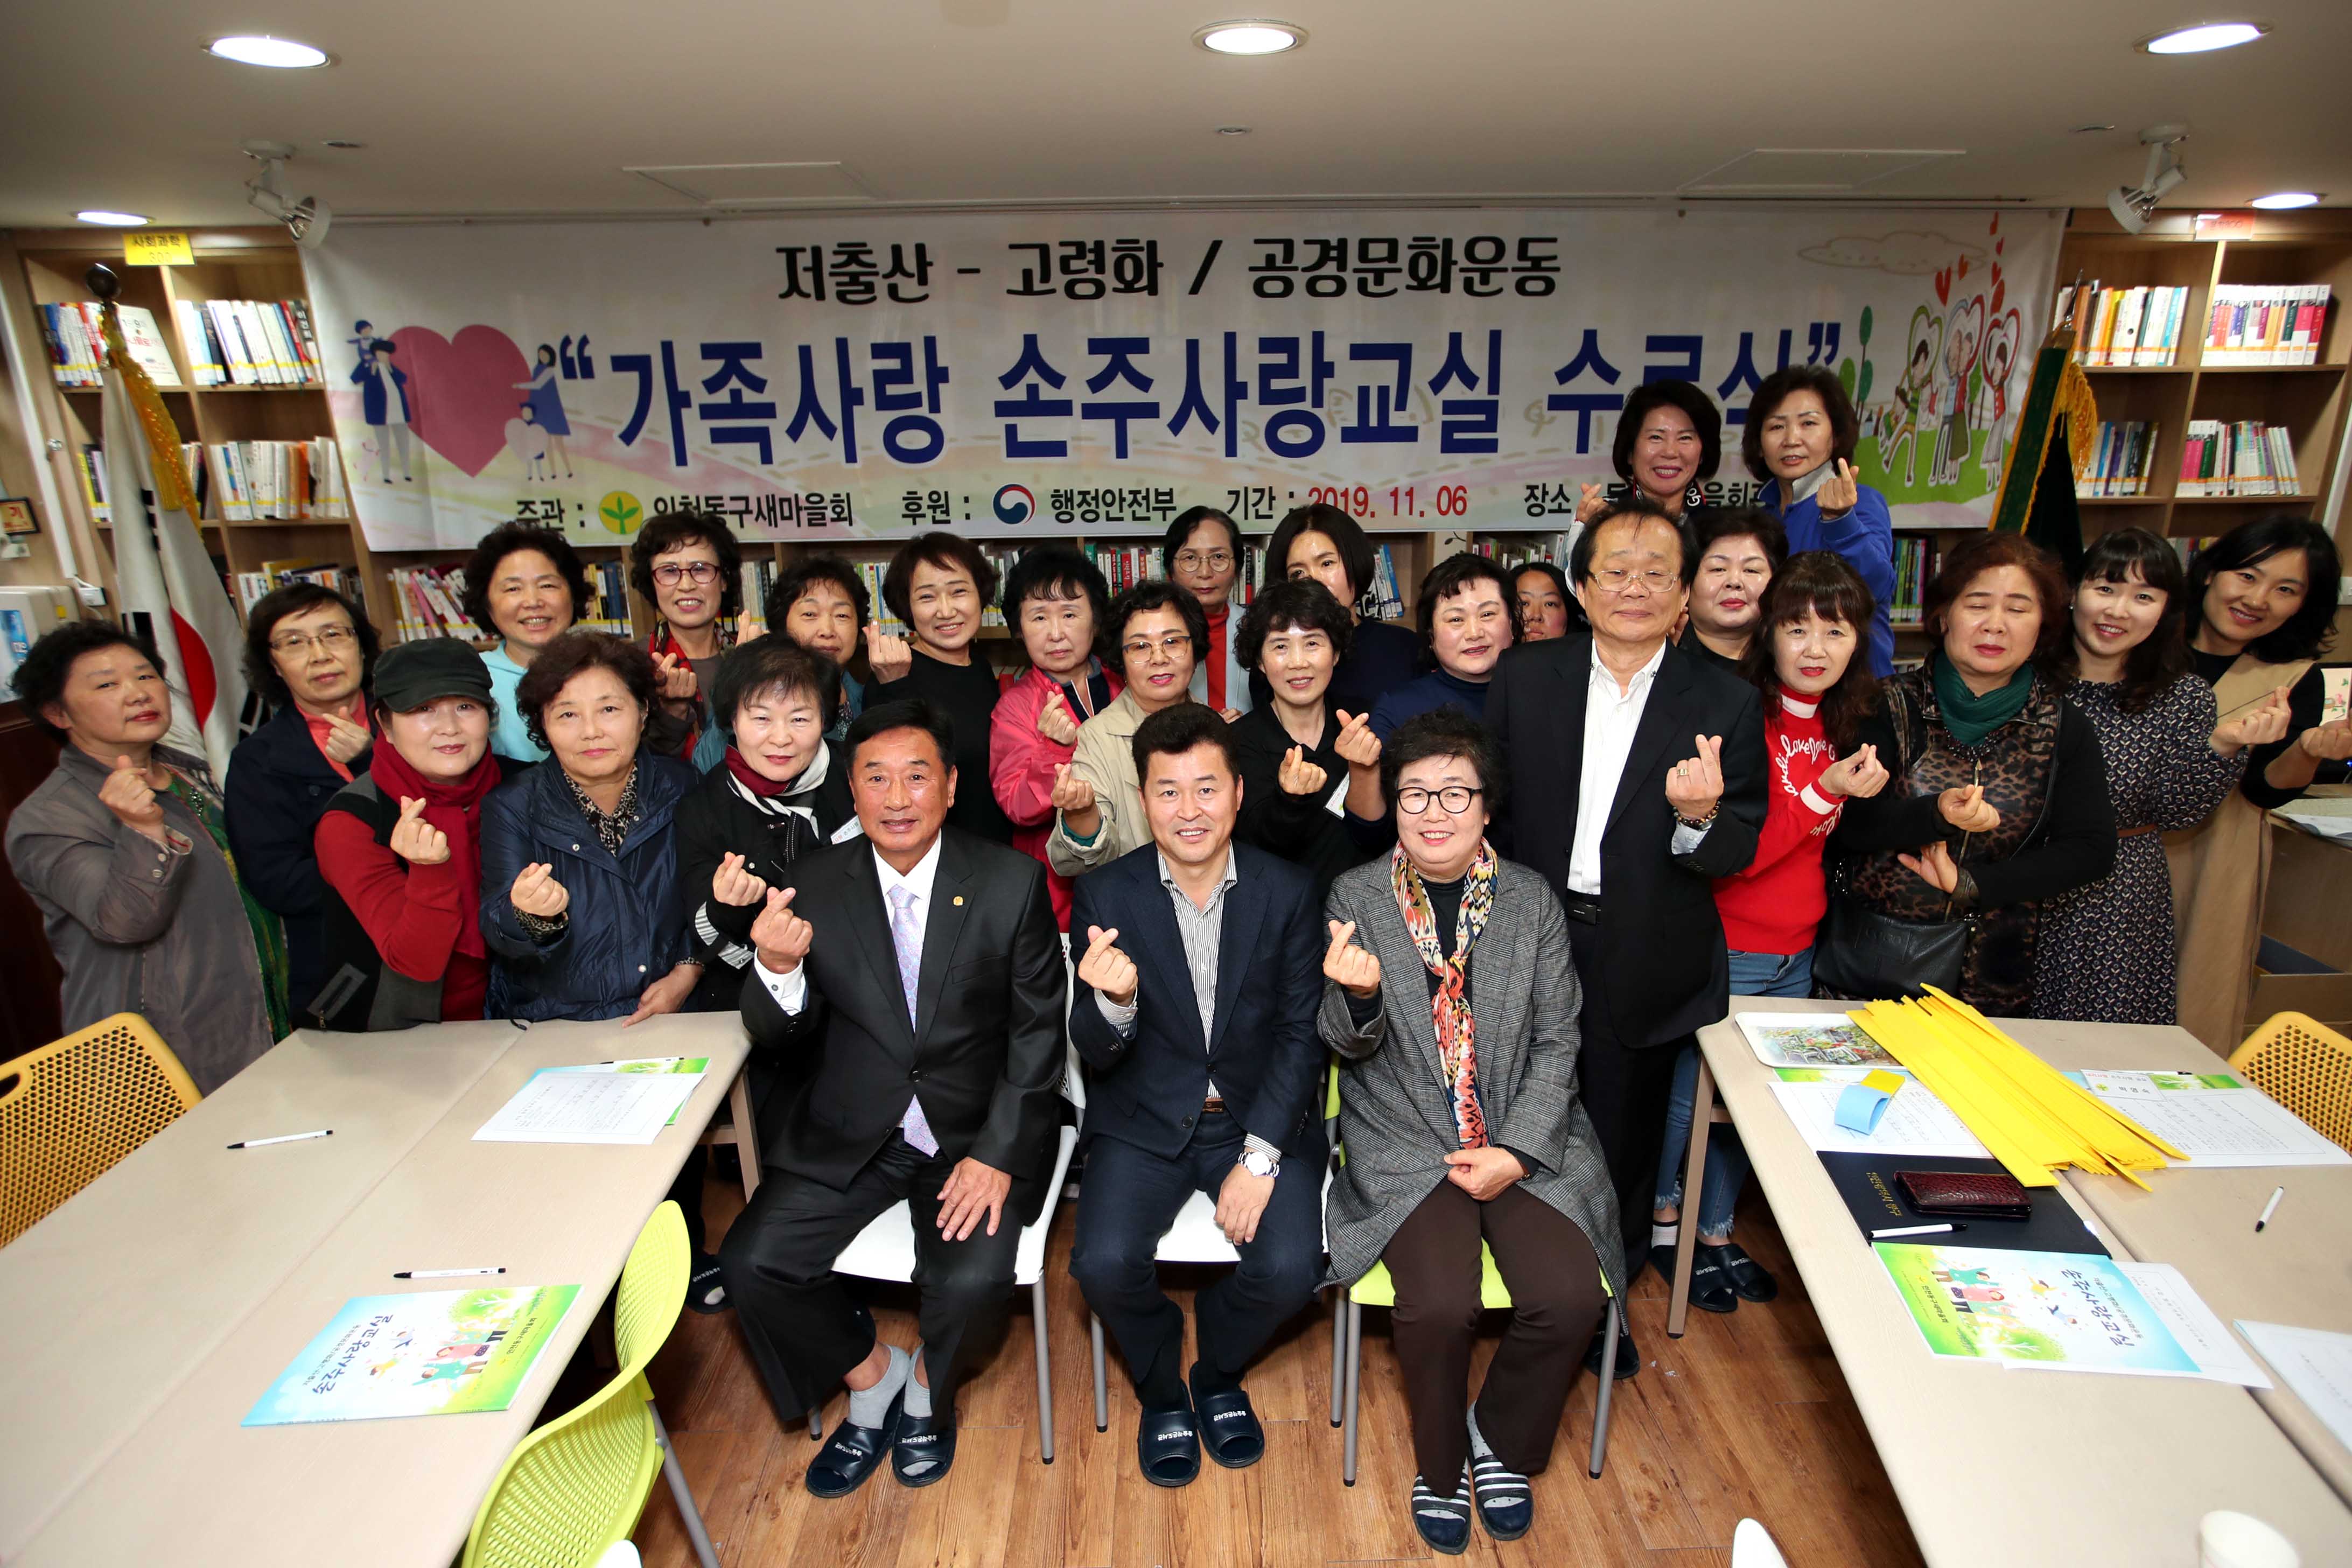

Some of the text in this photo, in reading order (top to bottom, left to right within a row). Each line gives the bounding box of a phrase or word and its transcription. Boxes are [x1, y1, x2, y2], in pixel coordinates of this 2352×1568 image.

[133, 233, 181, 248] 사회과학
[149, 251, 172, 263] 300
[775, 242, 934, 305] 저출산
[1006, 239, 1164, 300] 고령화
[1248, 235, 1561, 298] 공경문화운동
[993, 330, 1502, 459] 손주사랑교실
[516, 498, 565, 532] 주관
[901, 490, 951, 526] 후원
[1051, 488, 1177, 524] 행정안전부
[1227, 486, 1276, 520] 기간
[1390, 486, 1425, 517] 11.
[1437, 485, 1468, 516] 06
[1524, 482, 1572, 517] 장소
